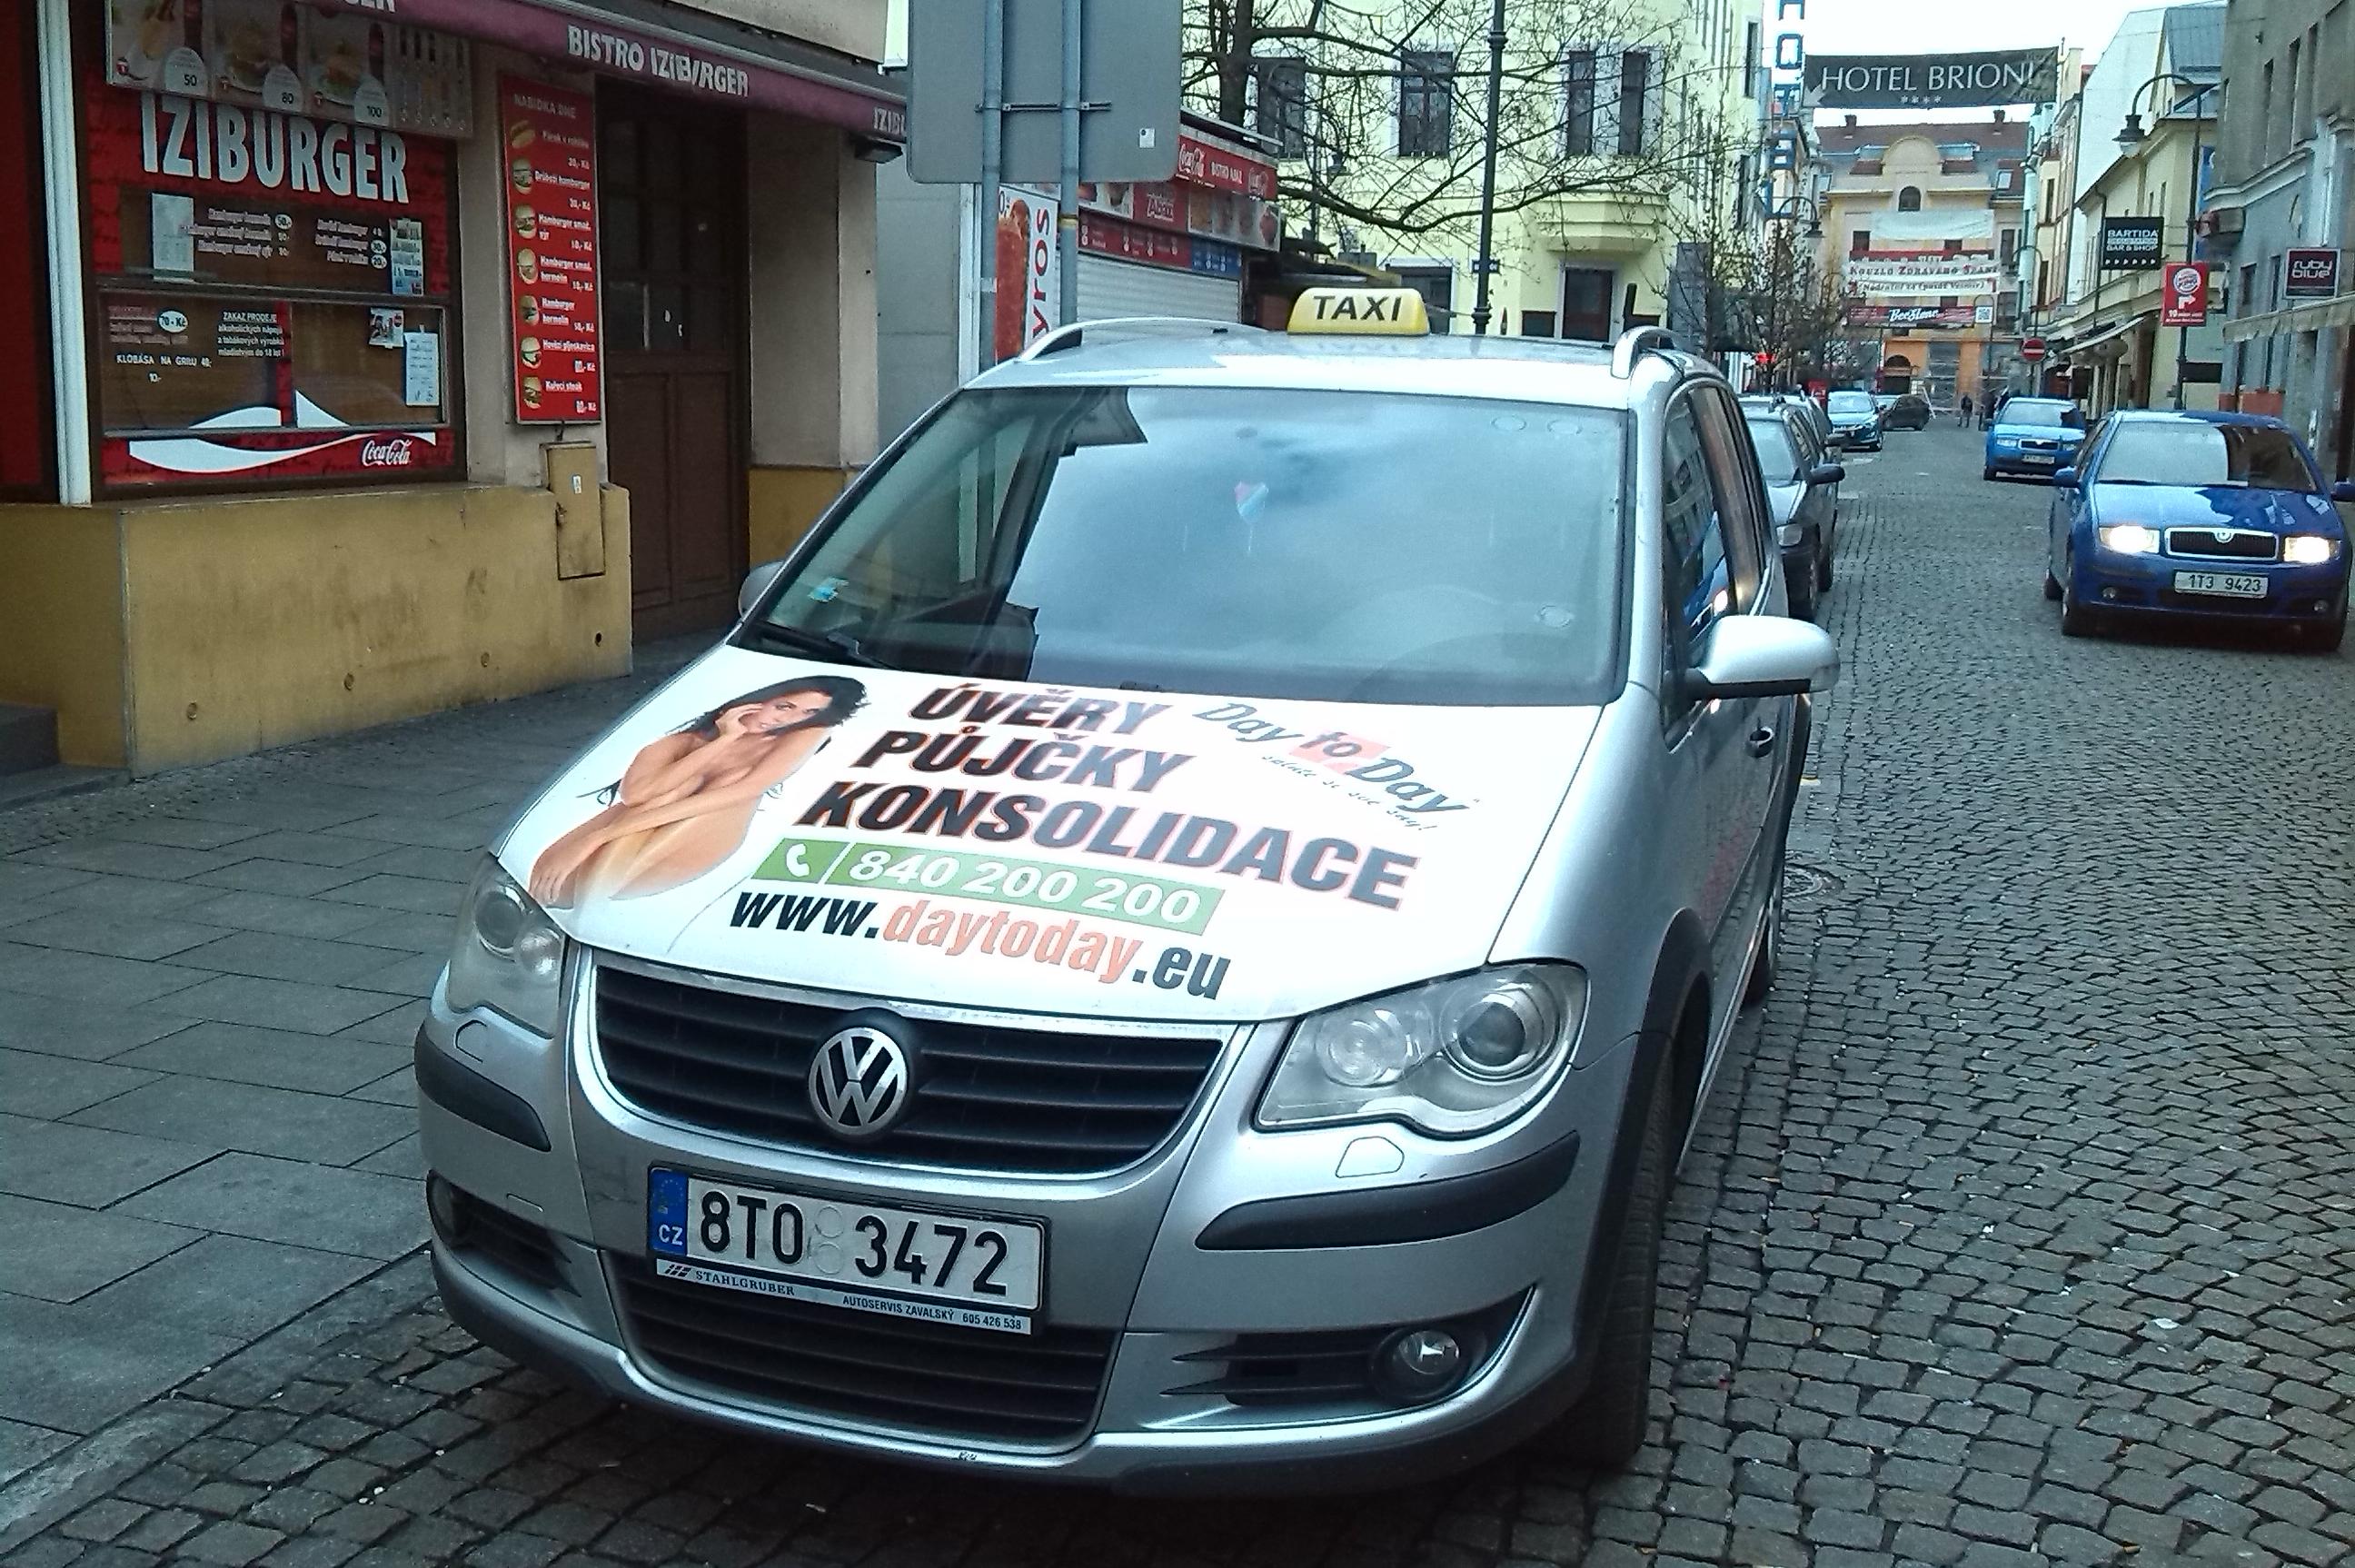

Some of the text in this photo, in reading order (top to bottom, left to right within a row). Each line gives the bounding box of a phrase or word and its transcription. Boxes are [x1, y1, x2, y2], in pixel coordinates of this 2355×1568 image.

[568, 25, 644, 72] BISTRO
[184, 74, 197, 86] 50
[1822, 63, 2034, 92] HOTEL BRIONI
[367, 105, 383, 118] 100
[141, 93, 410, 203] IZIBURGER
[2108, 229, 2159, 238] BARTIDA
[2293, 260, 2333, 271] ruby
[1313, 295, 1403, 322] TAXI
[160, 355, 172, 365] NA
[2189, 574, 2261, 592] 1T3 9423
[908, 682, 1174, 735] ÚVĚRY
[850, 726, 1197, 793] PŮJČKY
[1192, 702, 1471, 813] Day to Day
[792, 780, 1422, 911] KONSOLIDACE
[849, 849, 1202, 925] 840 200 200
[730, 891, 1232, 1000] www.daytoday.eu
[658, 1224, 683, 1247] CZ
[854, 1215, 1009, 1297] 3472
[695, 1269, 795, 1296] STAHLGRUBER
[842, 1295, 1022, 1331] AUTOSERVIS ZAVALSKÝ 605 426 538
